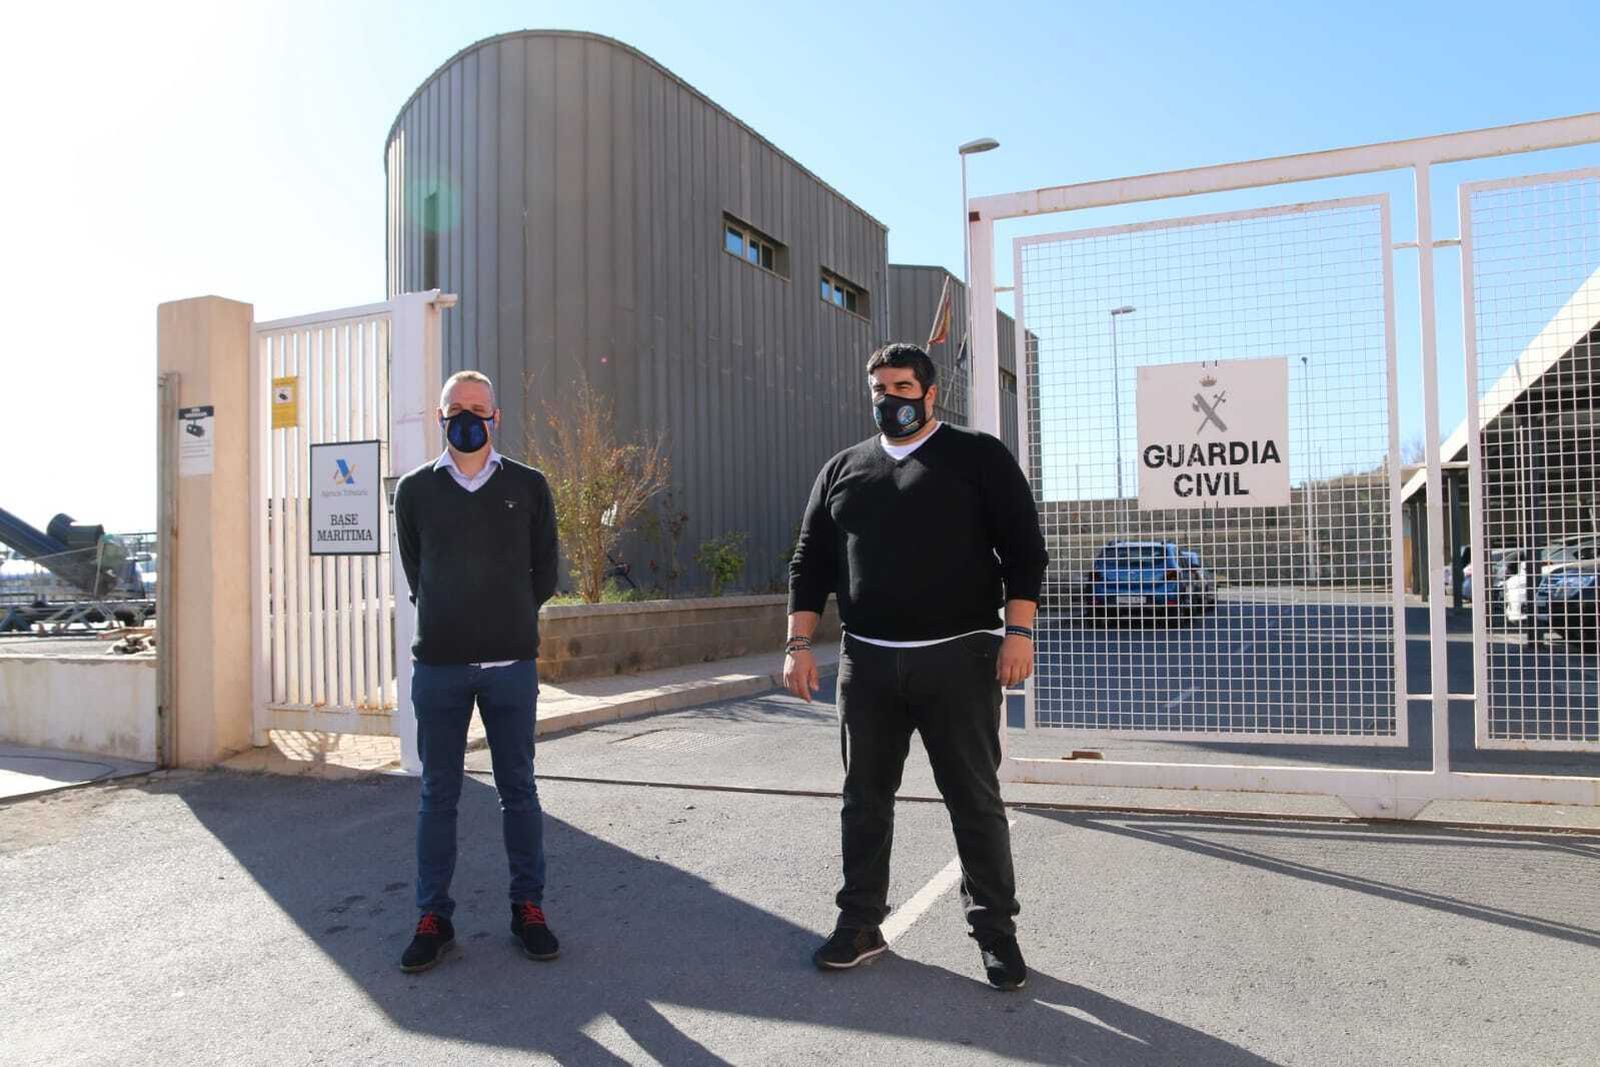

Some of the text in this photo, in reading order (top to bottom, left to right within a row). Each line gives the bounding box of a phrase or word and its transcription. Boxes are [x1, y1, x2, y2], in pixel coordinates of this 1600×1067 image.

[1143, 440, 1281, 468] GUARDIA
[1174, 472, 1249, 497] CIVIL
[330, 513, 359, 526] BASE
[317, 529, 373, 541] MARITIMA
